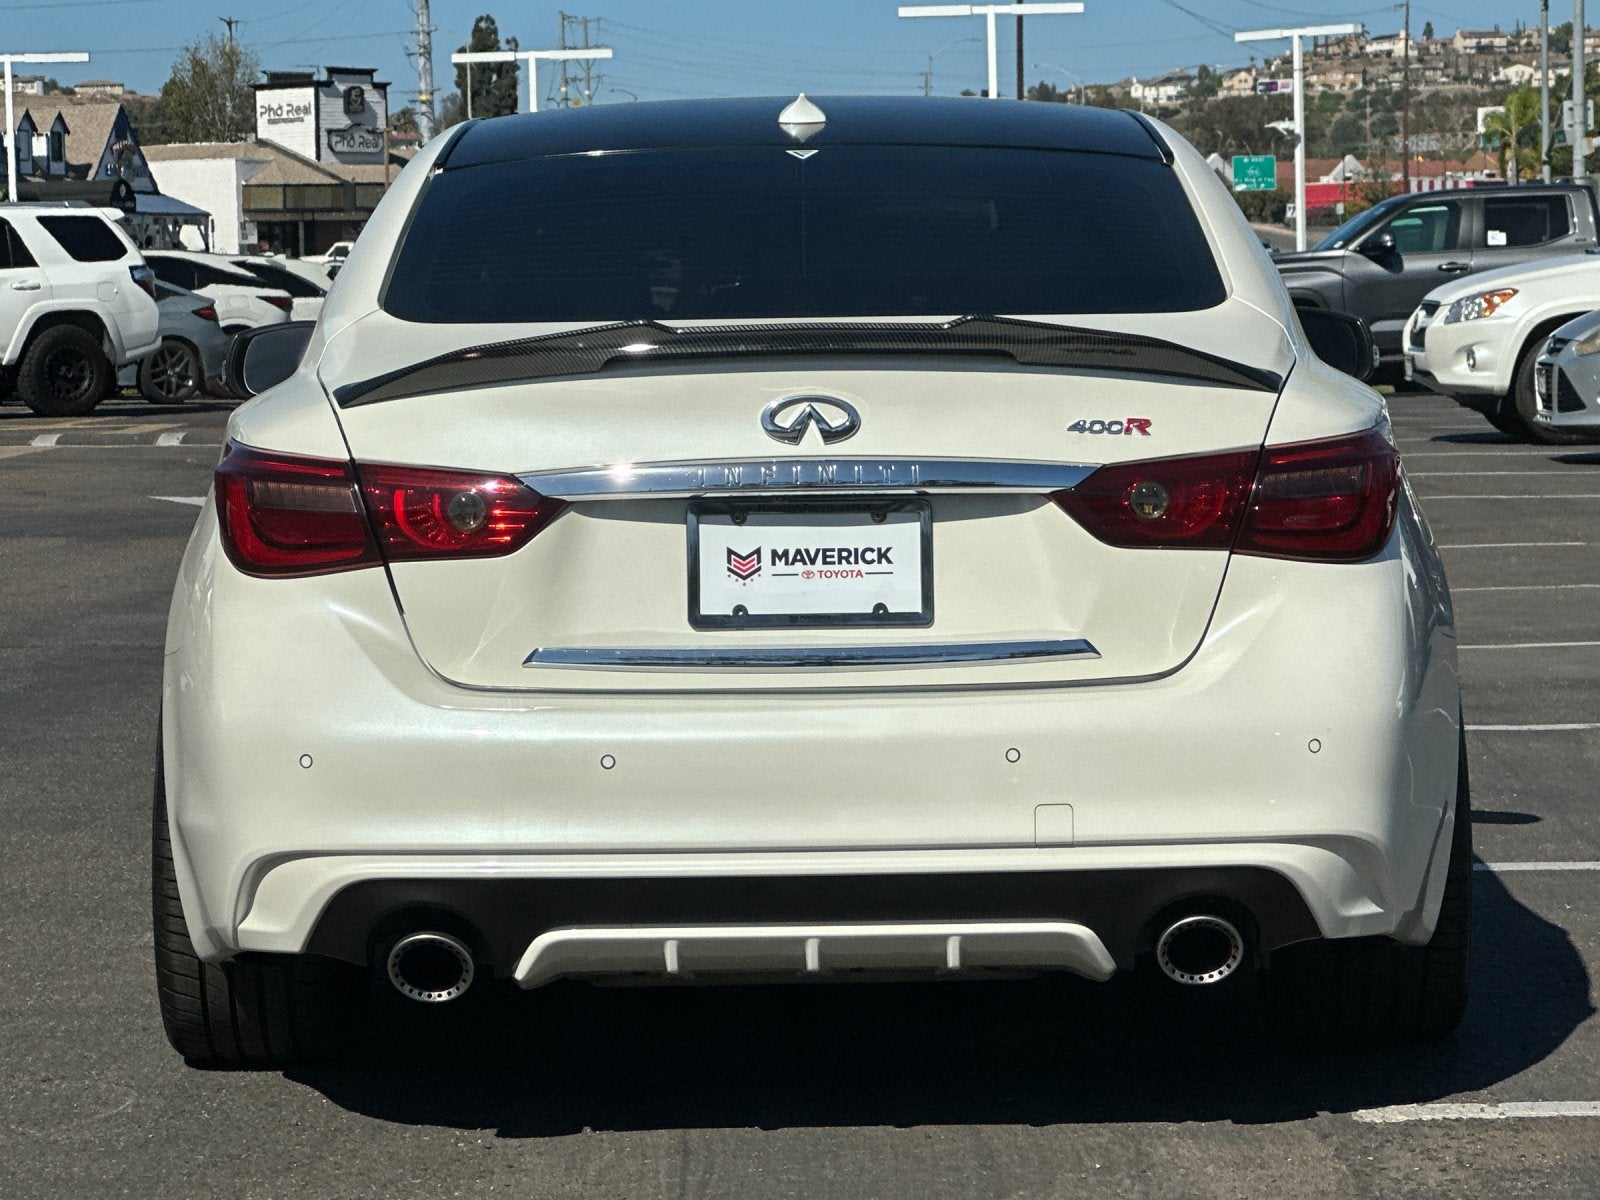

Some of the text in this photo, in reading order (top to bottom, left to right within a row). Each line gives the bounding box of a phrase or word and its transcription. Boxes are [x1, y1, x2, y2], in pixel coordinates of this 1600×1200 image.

[286, 101, 312, 117] Real
[358, 133, 380, 149] Real
[1066, 417, 1152, 436] 400R
[697, 464, 920, 487] INFINITI
[770, 546, 894, 567] MAVERICK
[817, 569, 864, 579] TOYOTA
